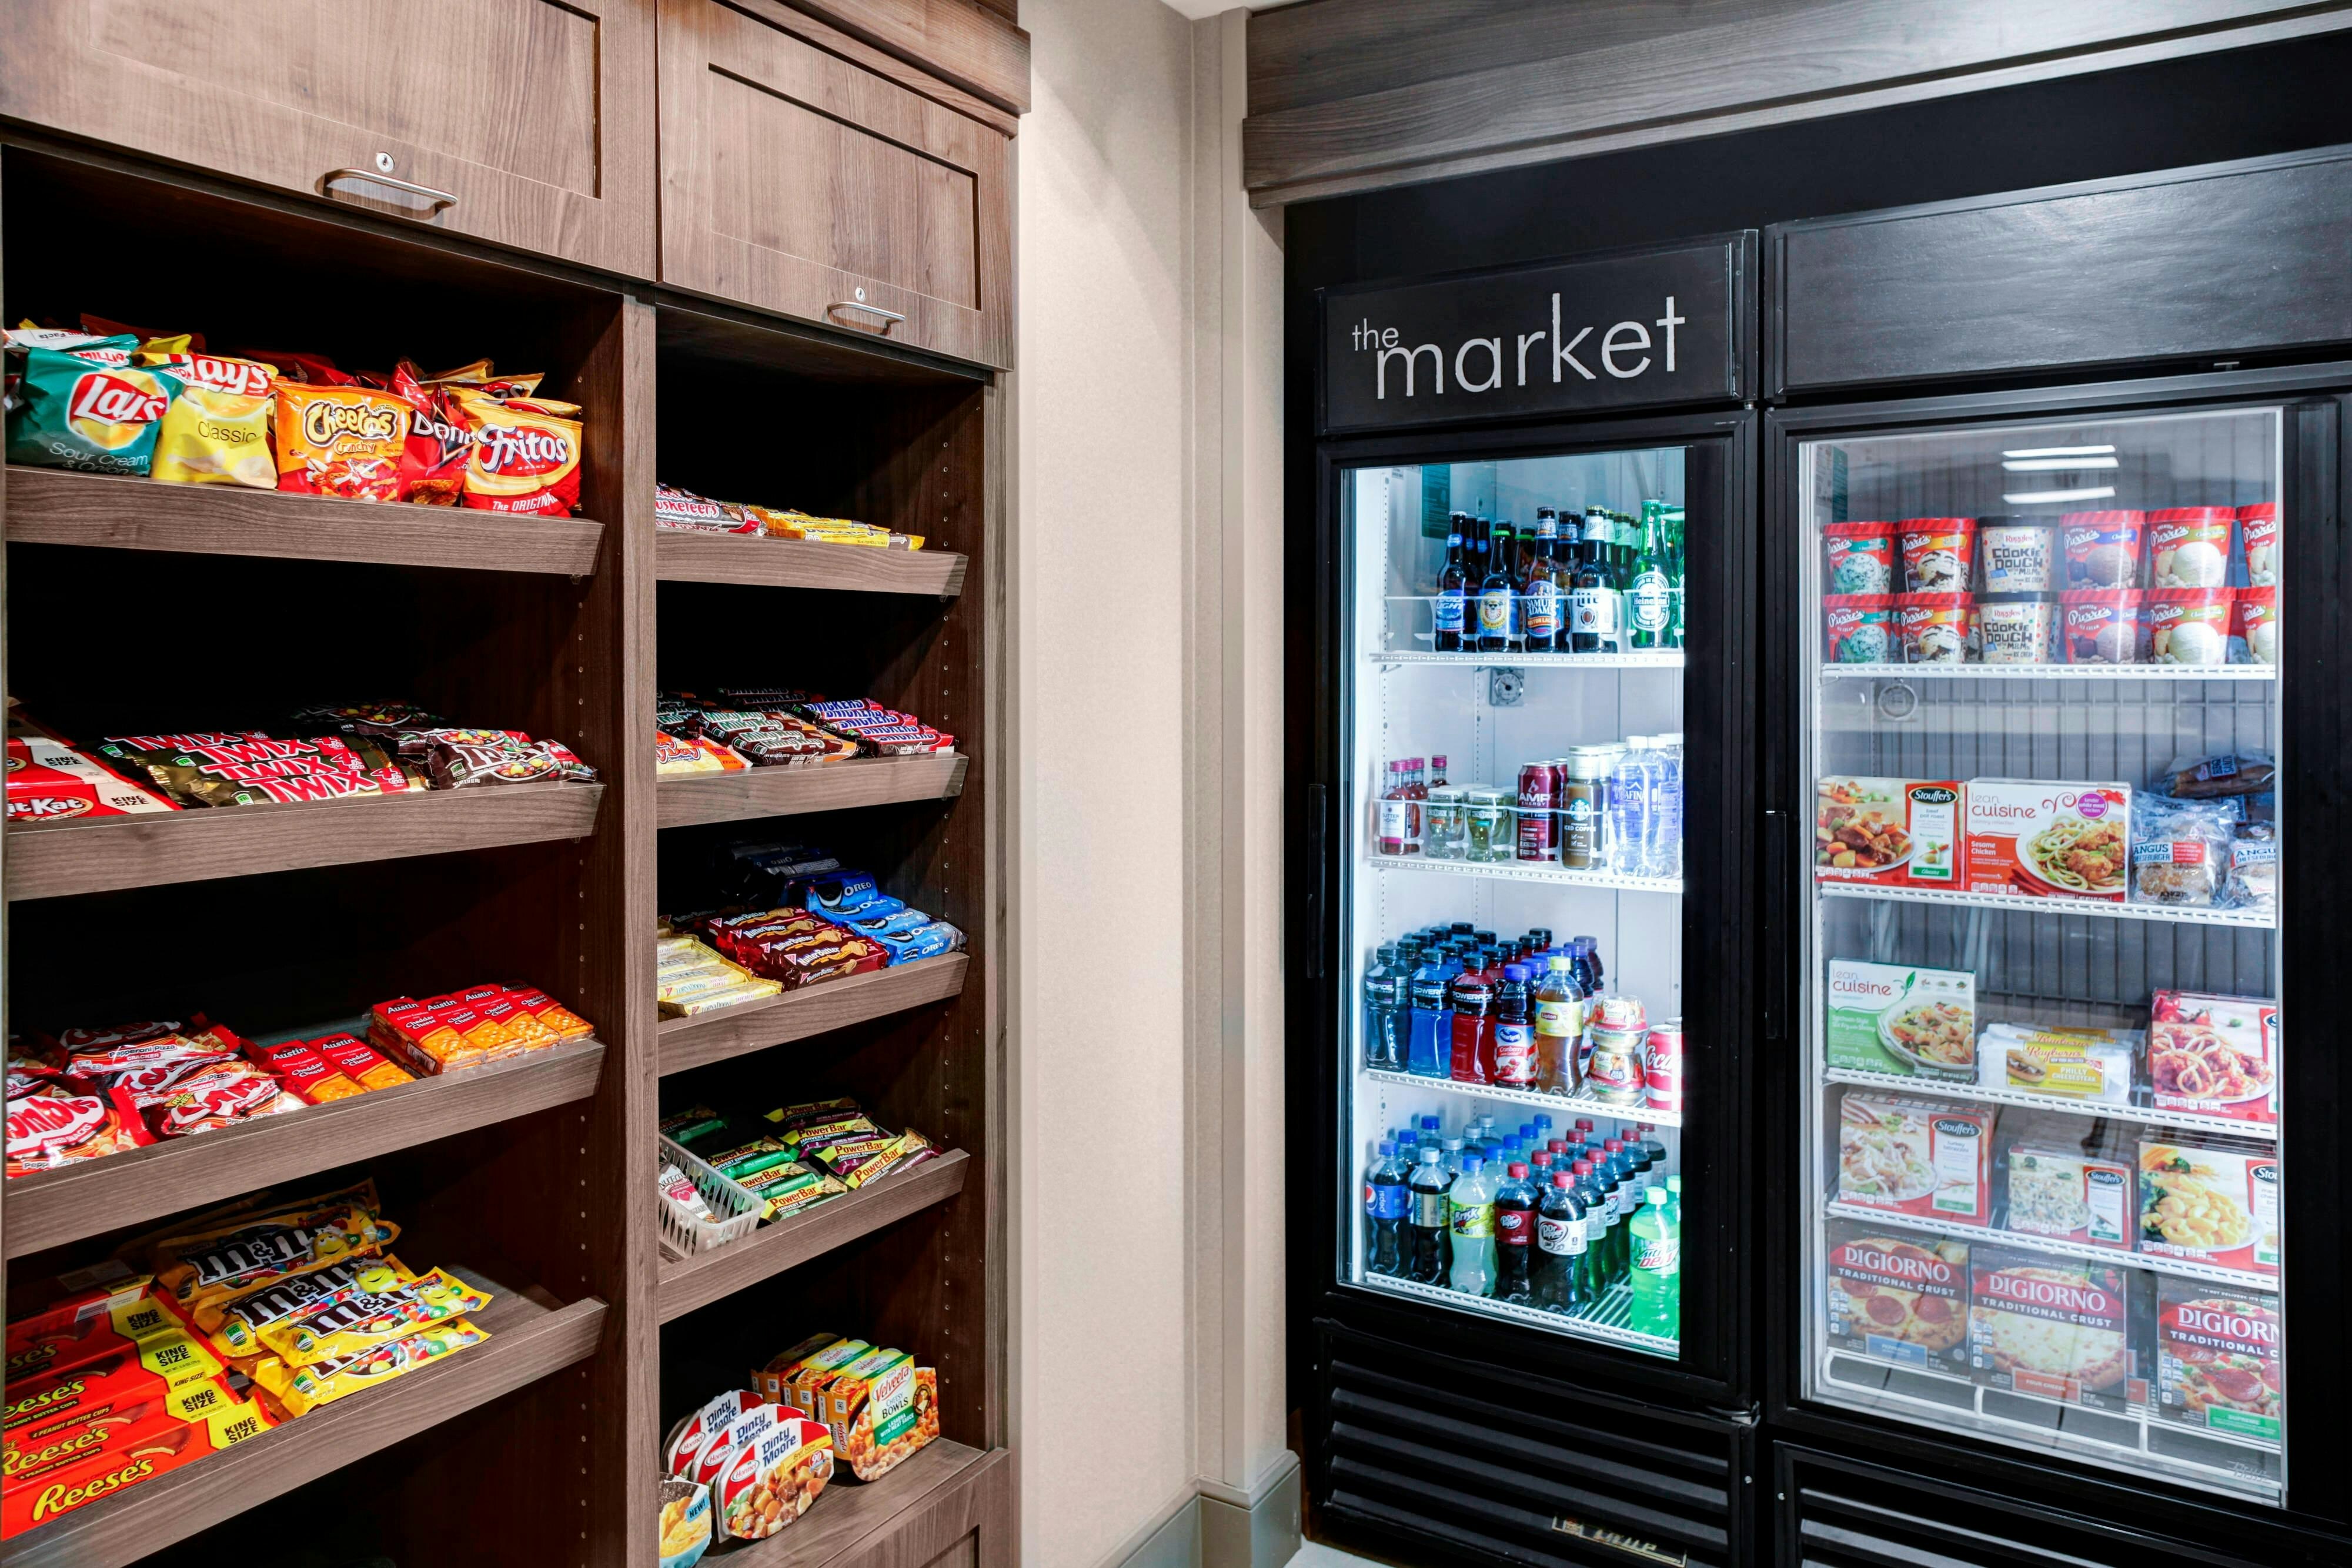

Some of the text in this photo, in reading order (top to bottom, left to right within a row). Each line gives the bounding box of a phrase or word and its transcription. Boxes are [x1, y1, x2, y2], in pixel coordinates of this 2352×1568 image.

[1352, 318, 1399, 351] the
[1377, 293, 1685, 399] market
[74, 375, 167, 426] Lay's
[305, 401, 396, 444] Cheetos
[198, 421, 257, 443] Classic
[49, 442, 148, 467] Sour Cream
[335, 441, 376, 455] Crunchy
[477, 423, 568, 473] Fritos
[493, 500, 509, 511] The
[656, 499, 720, 519] usketeers
[1992, 547, 2041, 559] COOKIE
[1995, 557, 2043, 570] DOUGH
[1984, 622, 2029, 633] COOKIE
[1986, 632, 2033, 644] DOUGH
[840, 714, 898, 729] SNICKERS
[103, 731, 243, 751] TWIX
[178, 738, 319, 765] TWIX
[199, 755, 339, 780] TWIX
[238, 770, 380, 803] TWIX
[111, 795, 146, 803] KING
[1519, 793, 1551, 802] AMP
[1914, 790, 1952, 803] Stouffer's
[1972, 791, 2000, 804] lean
[29, 796, 83, 817] Kat
[1972, 803, 2037, 819] cuisine
[2134, 843, 2169, 853] ANGUS
[844, 882, 872, 897] OREO
[1832, 968, 1858, 979] lean
[1833, 979, 1892, 996] cuisine
[465, 989, 495, 1002] Austin
[520, 993, 546, 1006] Cheddar
[527, 997, 548, 1008] Cheese
[387, 1002, 419, 1015] Austin
[426, 999, 457, 1011] Austin
[484, 1001, 510, 1016] Cheddar
[490, 1005, 513, 1017] Cheese
[405, 1015, 434, 1028] Cheddar
[447, 1010, 474, 1024] Cheddar
[454, 1013, 477, 1025] Cheese
[109, 1044, 176, 1059] Pepperoni Pizza
[322, 1038, 356, 1051] Austin
[127, 1052, 160, 1061] CRACKER
[273, 1047, 309, 1061] Austin
[341, 1051, 372, 1065] Cheddar
[2060, 1067, 2087, 1075] PHILLY
[6, 1097, 99, 1139] ombos
[66, 1124, 92, 1143] SNACKS
[797, 1124, 847, 1138] PowerBar
[1937, 1121, 1976, 1135] Stouffer's
[800, 1135, 823, 1144] HARVEST
[835, 1141, 883, 1154] PowerBar
[715, 1159, 736, 1171] ARVEST
[853, 1147, 900, 1182] PowerBar
[740, 1168, 781, 1188] owerBar
[2090, 1171, 2120, 1183] Stouffer's
[770, 1185, 817, 1208] PowerBar
[1378, 1190, 1387, 1213] pepsi
[1845, 1245, 1951, 1283] DIGIORNO
[1838, 1268, 1956, 1298] TRADITIONAL CRUST
[1989, 1273, 2107, 1313] DIGIORNO
[126, 1309, 159, 1323] KING
[1981, 1296, 2112, 1328] TRADITIONAL CRUST
[131, 1315, 162, 1330] SIZE
[2169, 1330, 2265, 1356] TRADITIONAL
[155, 1344, 188, 1359] KING
[159, 1350, 191, 1367] SIZE
[875, 1365, 910, 1402] Velveeta
[4, 1380, 86, 1420] eese's
[886, 1392, 903, 1407] CHEESY
[33, 1406, 58, 1419] BUTTER
[59, 1399, 78, 1409] CUPS
[707, 1399, 731, 1427] Dinty
[881, 1396, 908, 1419] BOWLS
[38, 1423, 65, 1437] PEANUT
[67, 1413, 91, 1429] BUTTER
[93, 1406, 110, 1417] CUPS
[736, 1412, 766, 1439] Dinty
[683, 1434, 704, 1449] Hormel
[762, 1427, 790, 1455] Dinty
[710, 1447, 732, 1463] Hormel
[763, 1435, 797, 1468] Moore
[736, 1463, 757, 1478] Hormel
[33, 1459, 154, 1522] Reese's
[689, 1499, 707, 1519] NEW!
